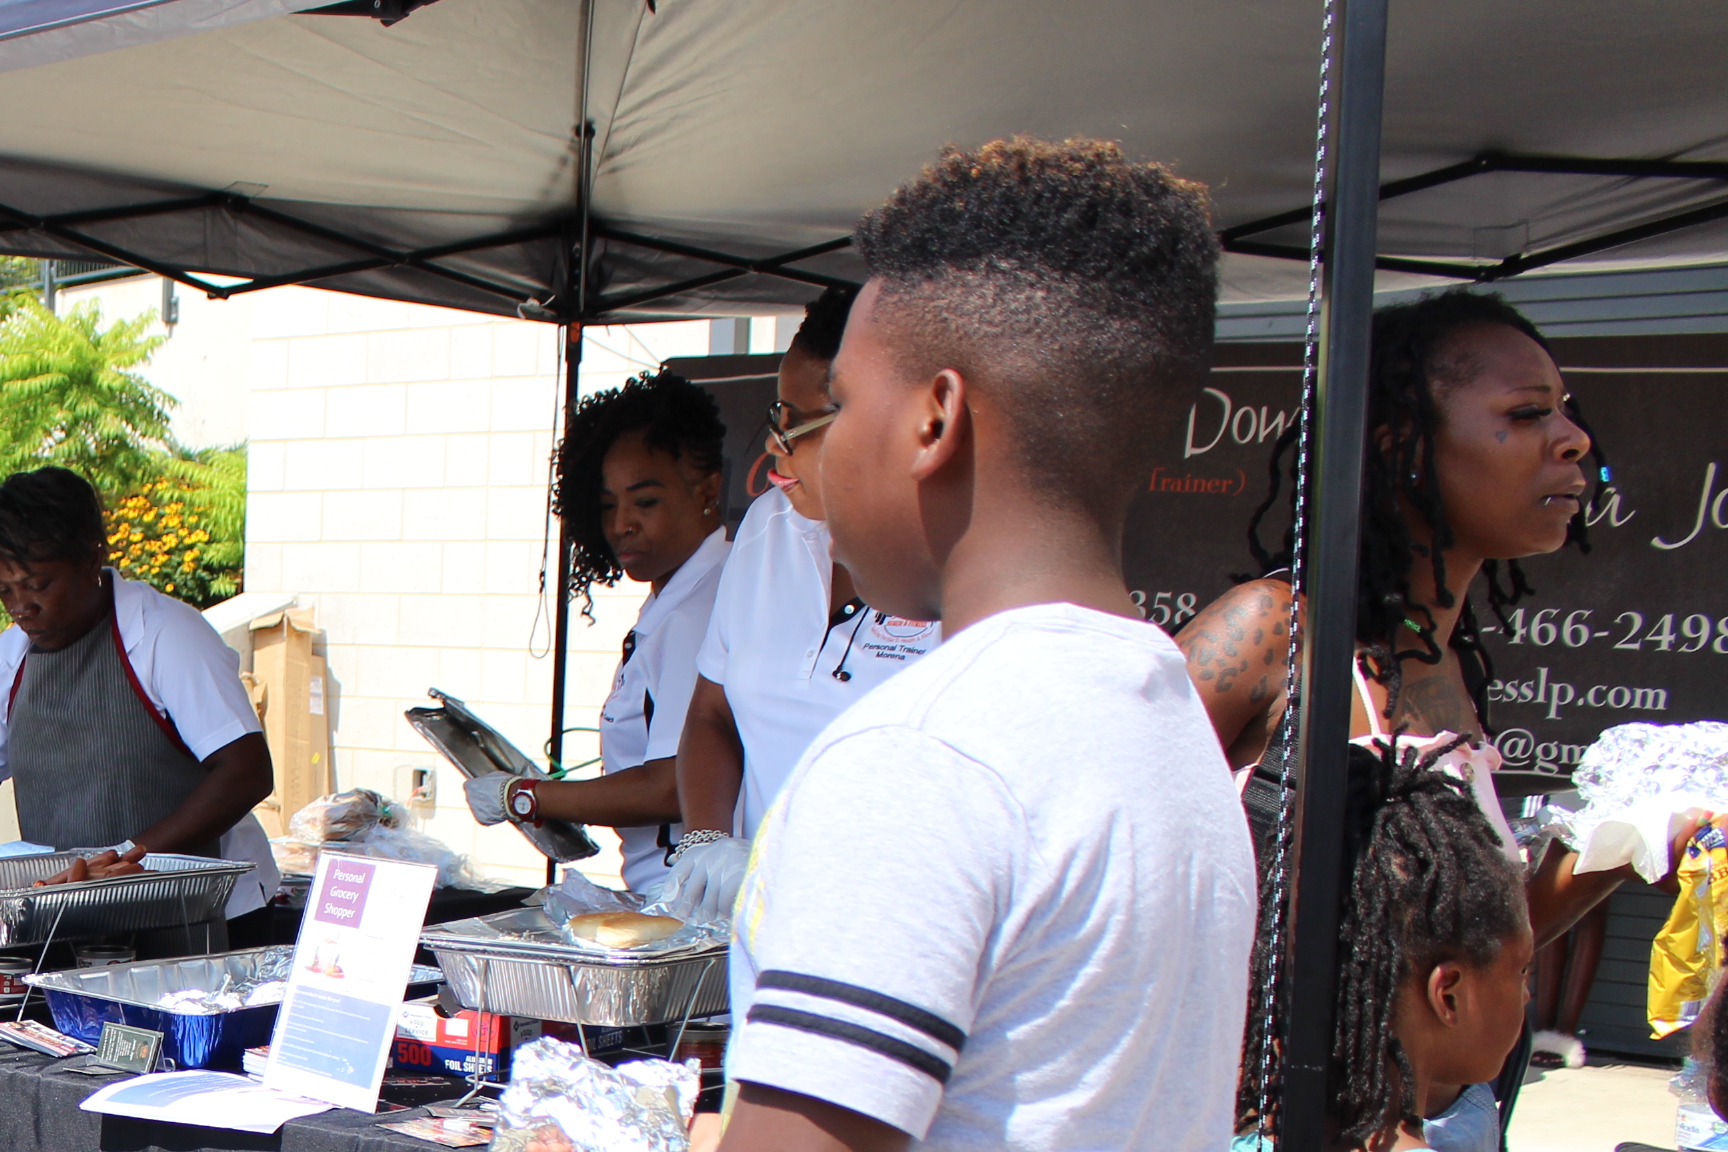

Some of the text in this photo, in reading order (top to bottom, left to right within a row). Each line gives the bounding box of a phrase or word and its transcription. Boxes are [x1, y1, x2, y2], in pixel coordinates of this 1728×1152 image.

[332, 868, 367, 884] Personal
[330, 886, 360, 904] Grocery
[323, 903, 356, 919] Shopper
[397, 1042, 432, 1067] 500
[444, 1059, 462, 1072] FOIL
